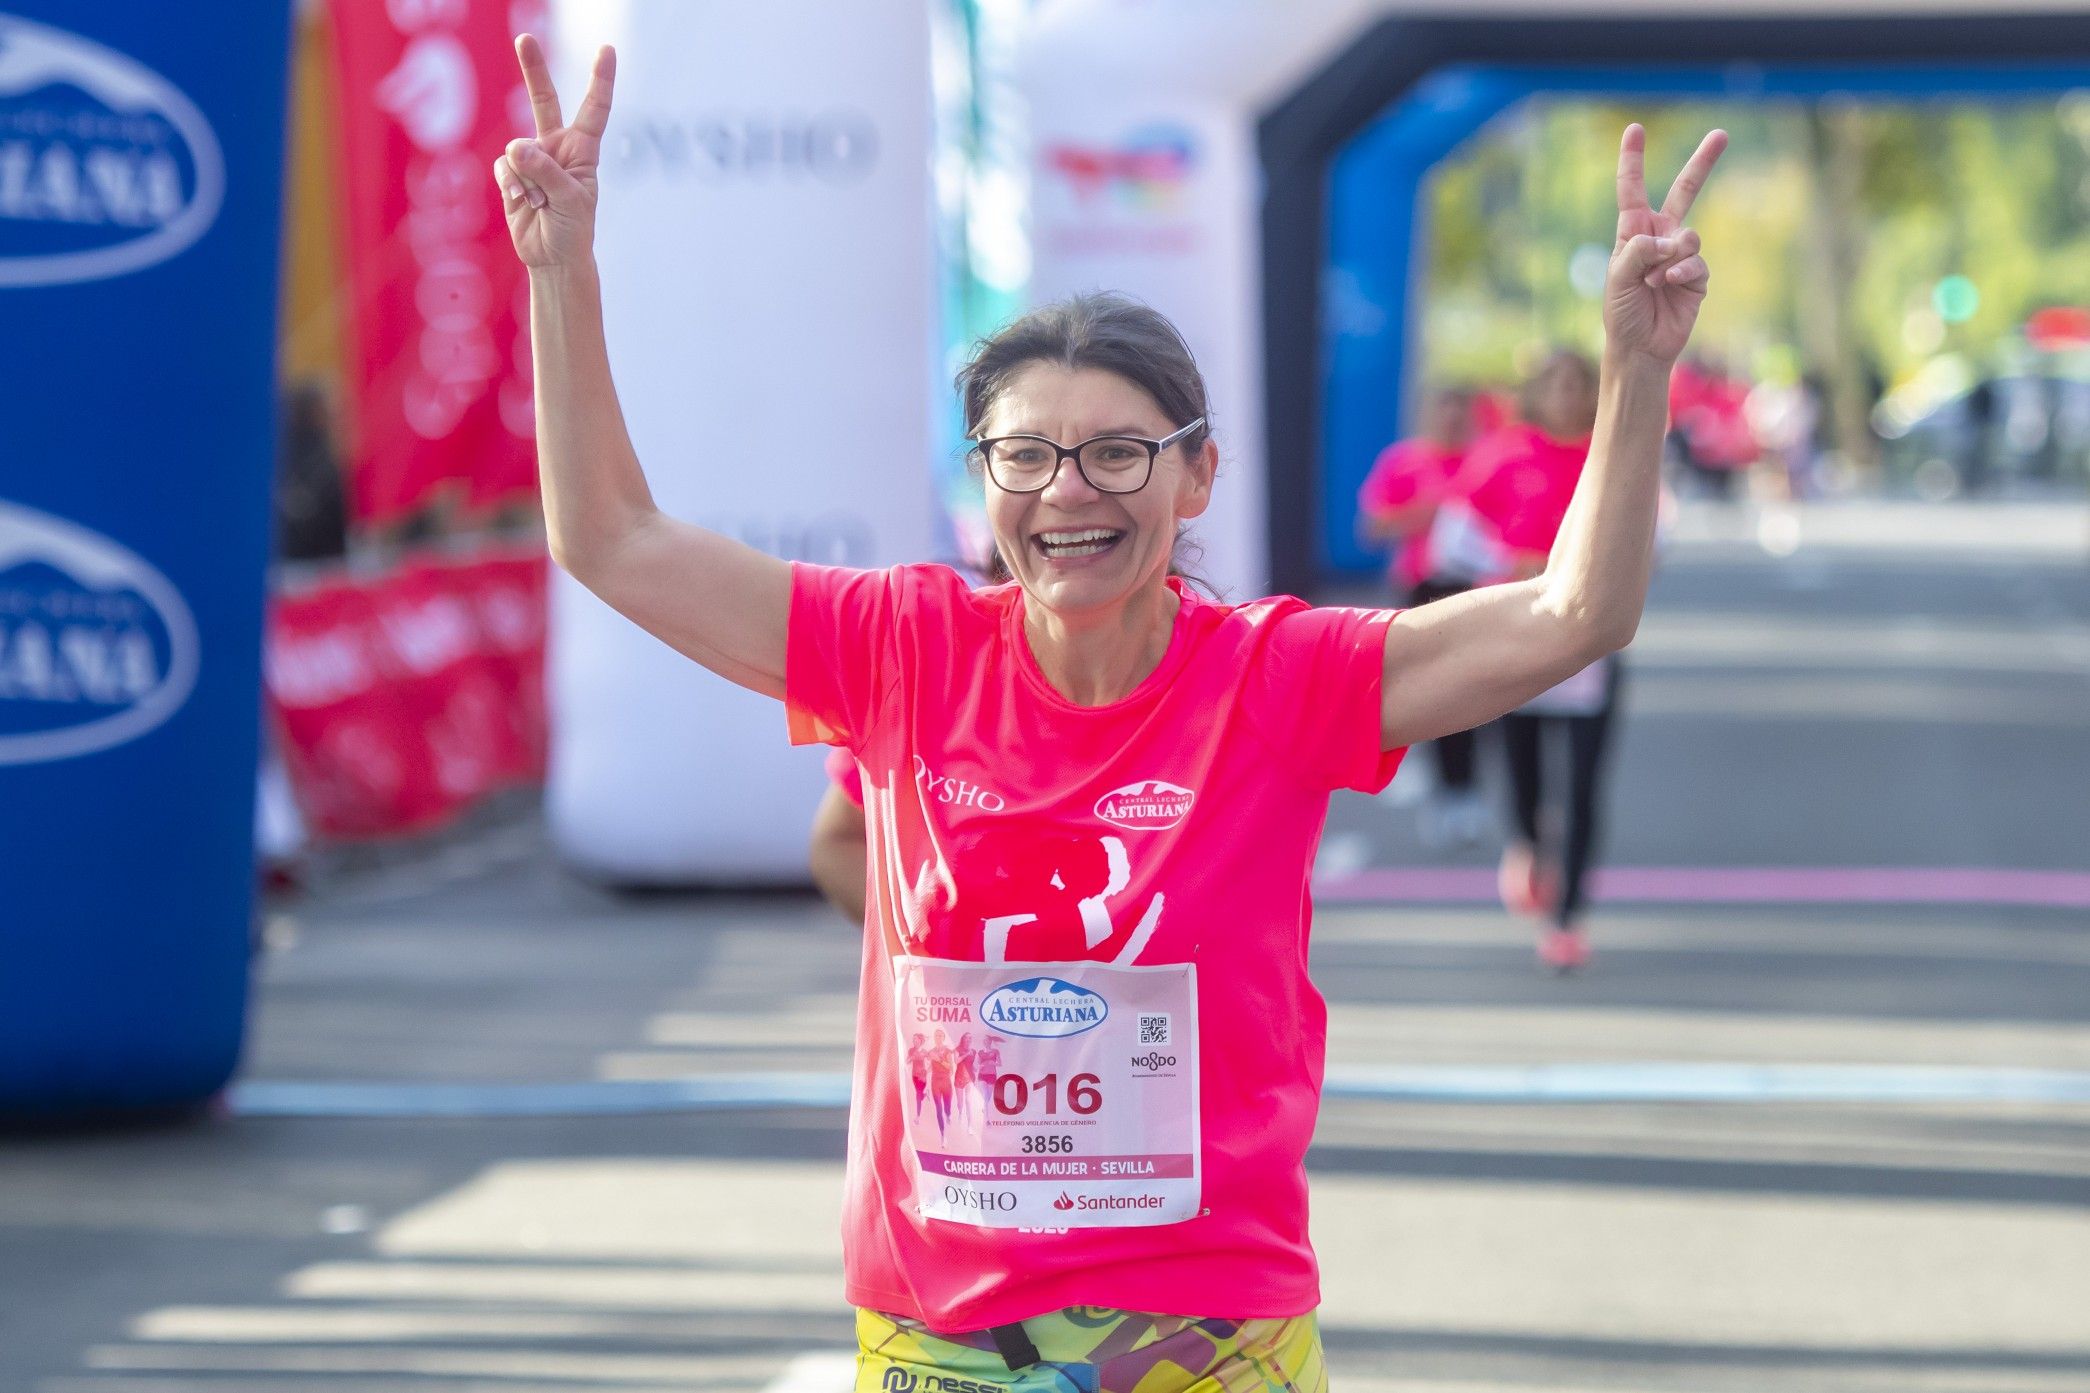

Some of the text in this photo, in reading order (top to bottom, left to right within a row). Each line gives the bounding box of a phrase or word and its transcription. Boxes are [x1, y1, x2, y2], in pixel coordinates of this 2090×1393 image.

[1103, 800, 1189, 819] ASTURIANA
[914, 996, 972, 1006] TU DORSAL
[1053, 997, 1094, 1005] LECHERA
[916, 1007, 972, 1023] SUMA
[989, 999, 1100, 1023] ASTURIANA
[993, 1072, 1103, 1116] 016
[1021, 1135, 1073, 1153] 3856
[944, 1160, 1155, 1176] CARRERA DE LA MUJER SEVILLA
[944, 1185, 1166, 1211] OYSHO Santander
